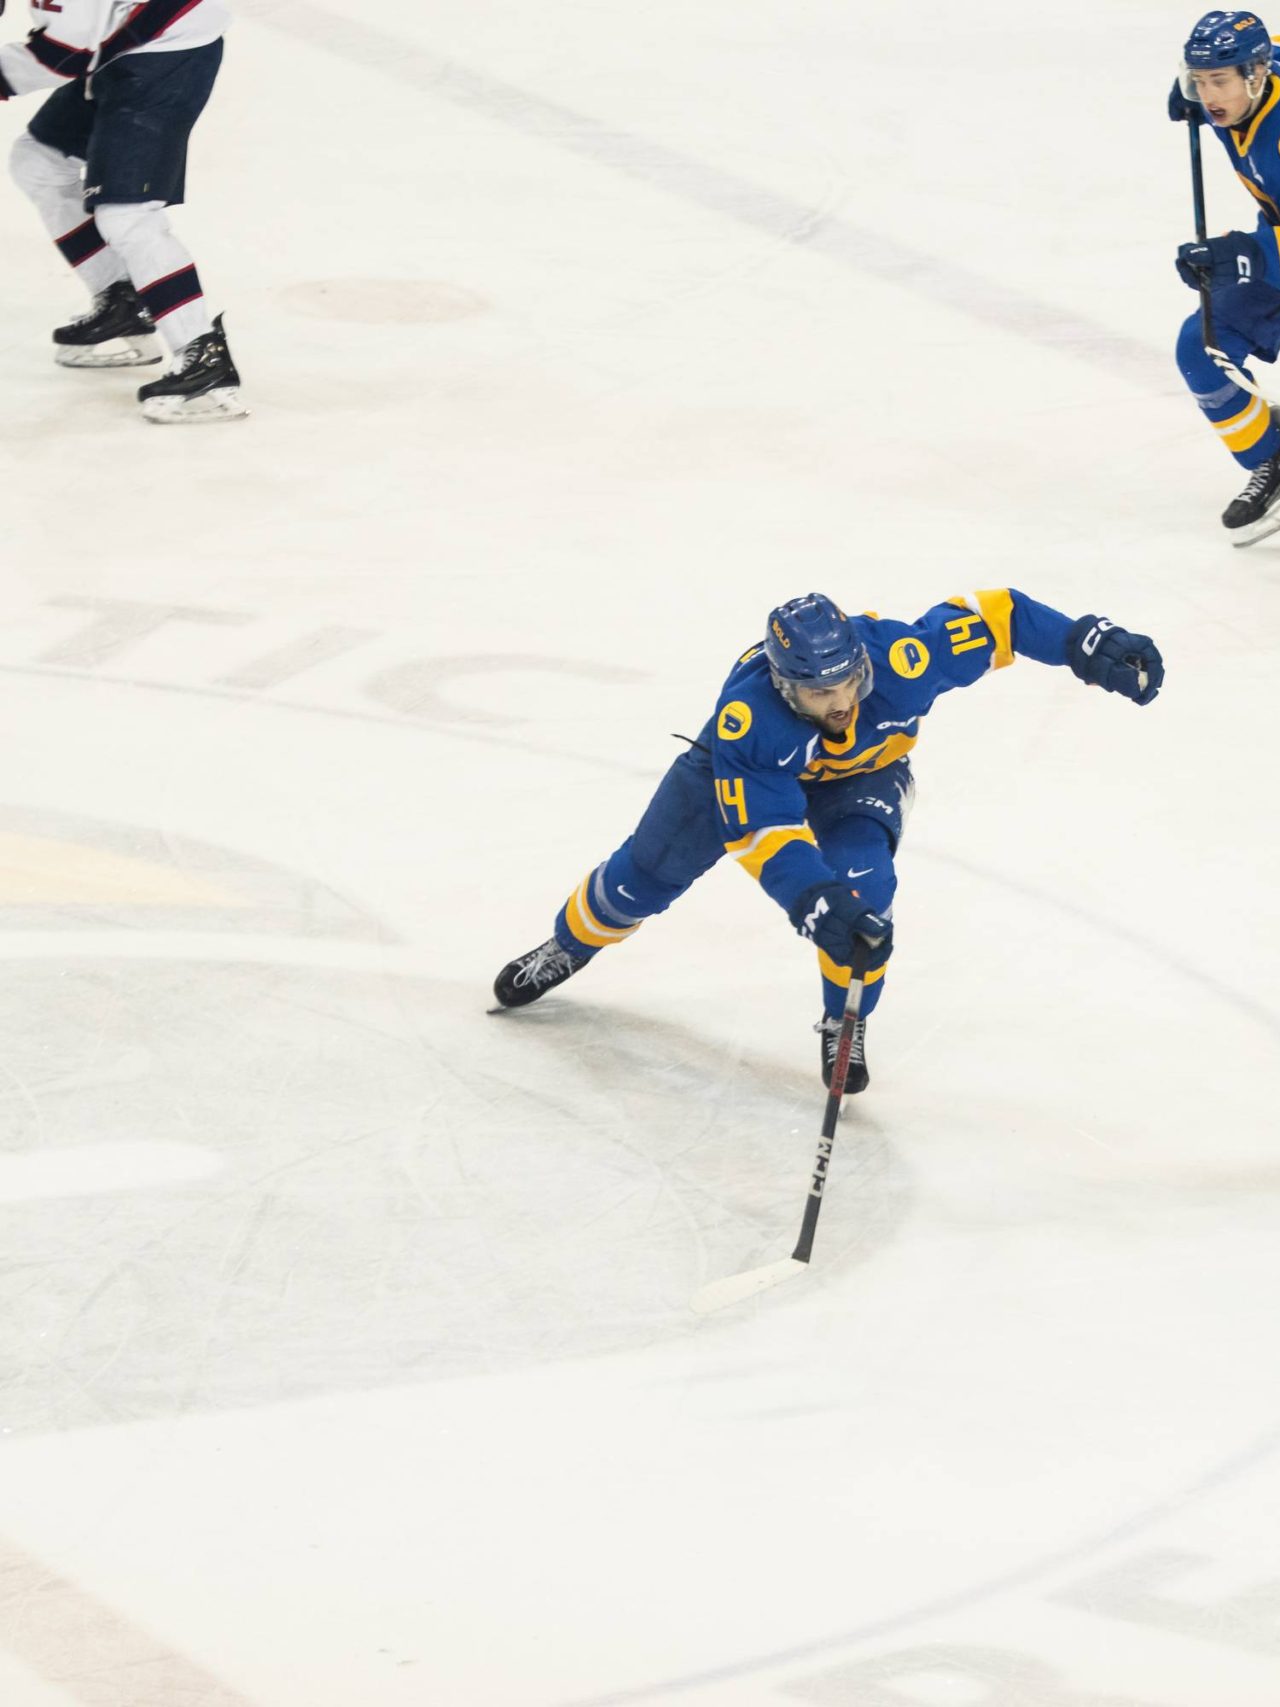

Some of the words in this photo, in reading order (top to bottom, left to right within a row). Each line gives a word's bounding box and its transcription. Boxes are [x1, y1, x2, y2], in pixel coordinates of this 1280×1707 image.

[944, 614, 988, 656] 14
[820, 660, 850, 675] CCM
[714, 778, 748, 825] 14
[807, 1135, 834, 1199] CCM
